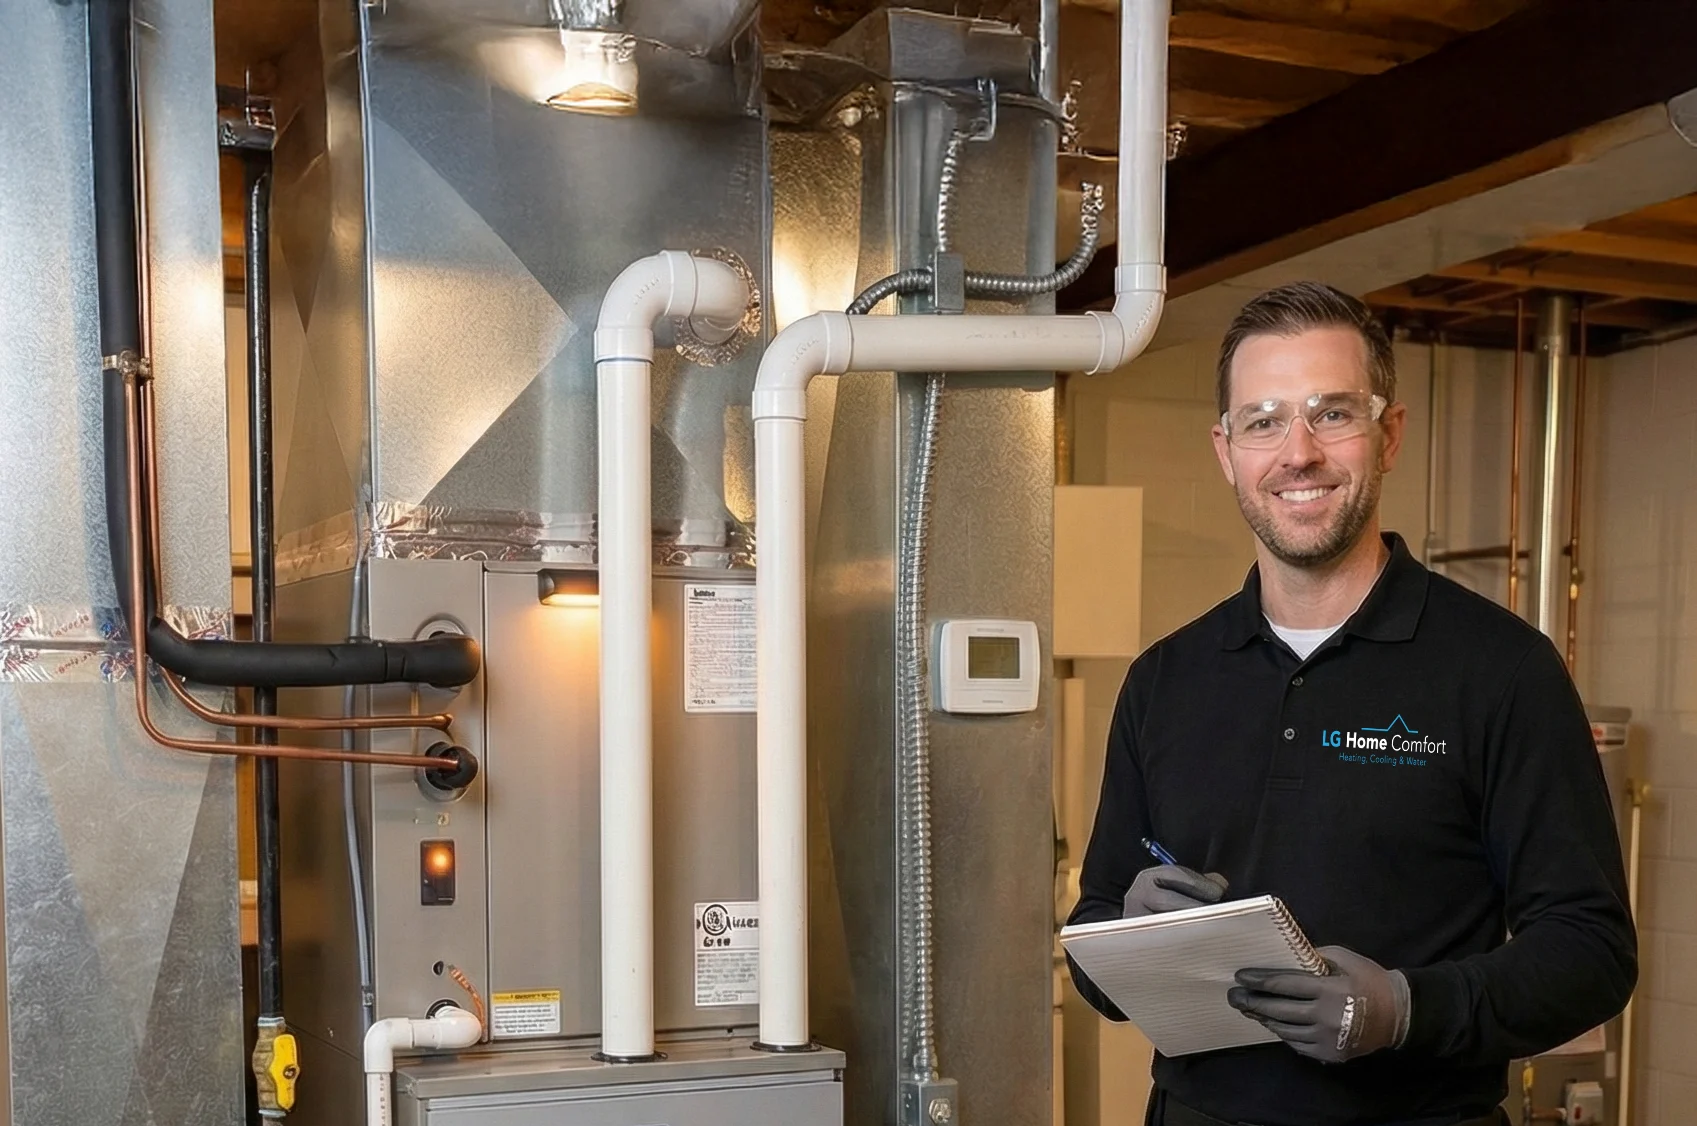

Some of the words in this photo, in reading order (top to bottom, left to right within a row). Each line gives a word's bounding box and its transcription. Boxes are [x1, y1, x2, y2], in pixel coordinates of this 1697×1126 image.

[1322, 730, 1341, 747] LG
[1345, 732, 1388, 750] Home
[1391, 734, 1447, 754] Comfort
[1339, 753, 1368, 764] Heating,
[1369, 754, 1397, 766] Cooling
[1399, 756, 1404, 765] &
[1406, 757, 1427, 766] Water
